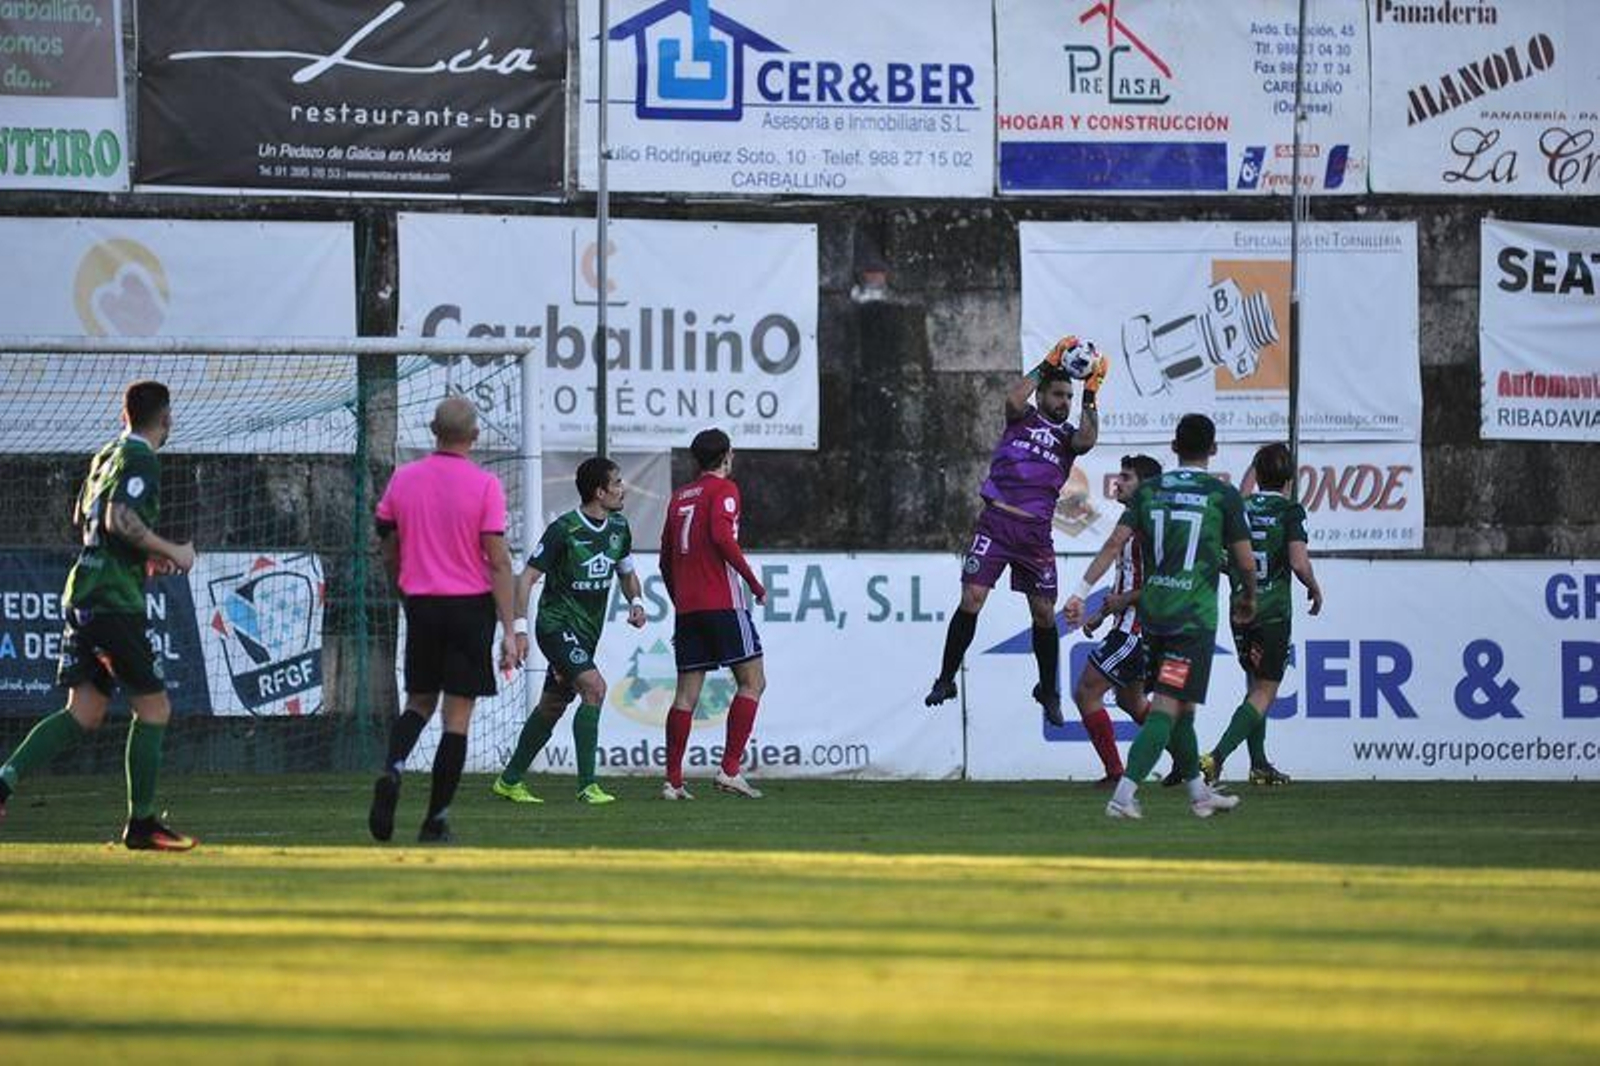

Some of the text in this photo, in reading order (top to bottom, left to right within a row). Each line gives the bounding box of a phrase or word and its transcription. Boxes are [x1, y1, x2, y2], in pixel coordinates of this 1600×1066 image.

[0, 0, 103, 31] arballiño,
[1279, 62, 1299, 75] 98
[1406, 32, 1556, 128] MANOLO
[757, 60, 975, 106] CER&BER
[1263, 80, 1342, 95] CARLLIÑO
[291, 104, 537, 130] restaurante-bar
[1273, 100, 1332, 115] (Ounse)
[1479, 110, 1567, 122] PANADERÍA
[834, 116, 844, 131] e
[849, 113, 935, 132] Inmobiliaria
[999, 112, 1229, 132] HOGAR Y CONSTRUCCIÓN
[258, 143, 451, 163] Un Pedazo de Galicia en Madrid
[609, 145, 640, 162] ulio
[787, 149, 806, 165] 10
[869, 151, 898, 166] 988
[904, 151, 922, 166] 27
[929, 151, 948, 166] 15
[953, 152, 973, 167] 02
[1443, 126, 1518, 184] La
[731, 169, 847, 190] CARBALLIÑO
[678, 504, 696, 554] 7
[1150, 509, 1203, 571] 17
[866, 575, 945, 622] S.L.
[563, 631, 579, 645] 4
[258, 660, 314, 698] RFGF
[1454, 638, 1525, 721] &
[1353, 737, 1600, 767] www.grupocerber.c
